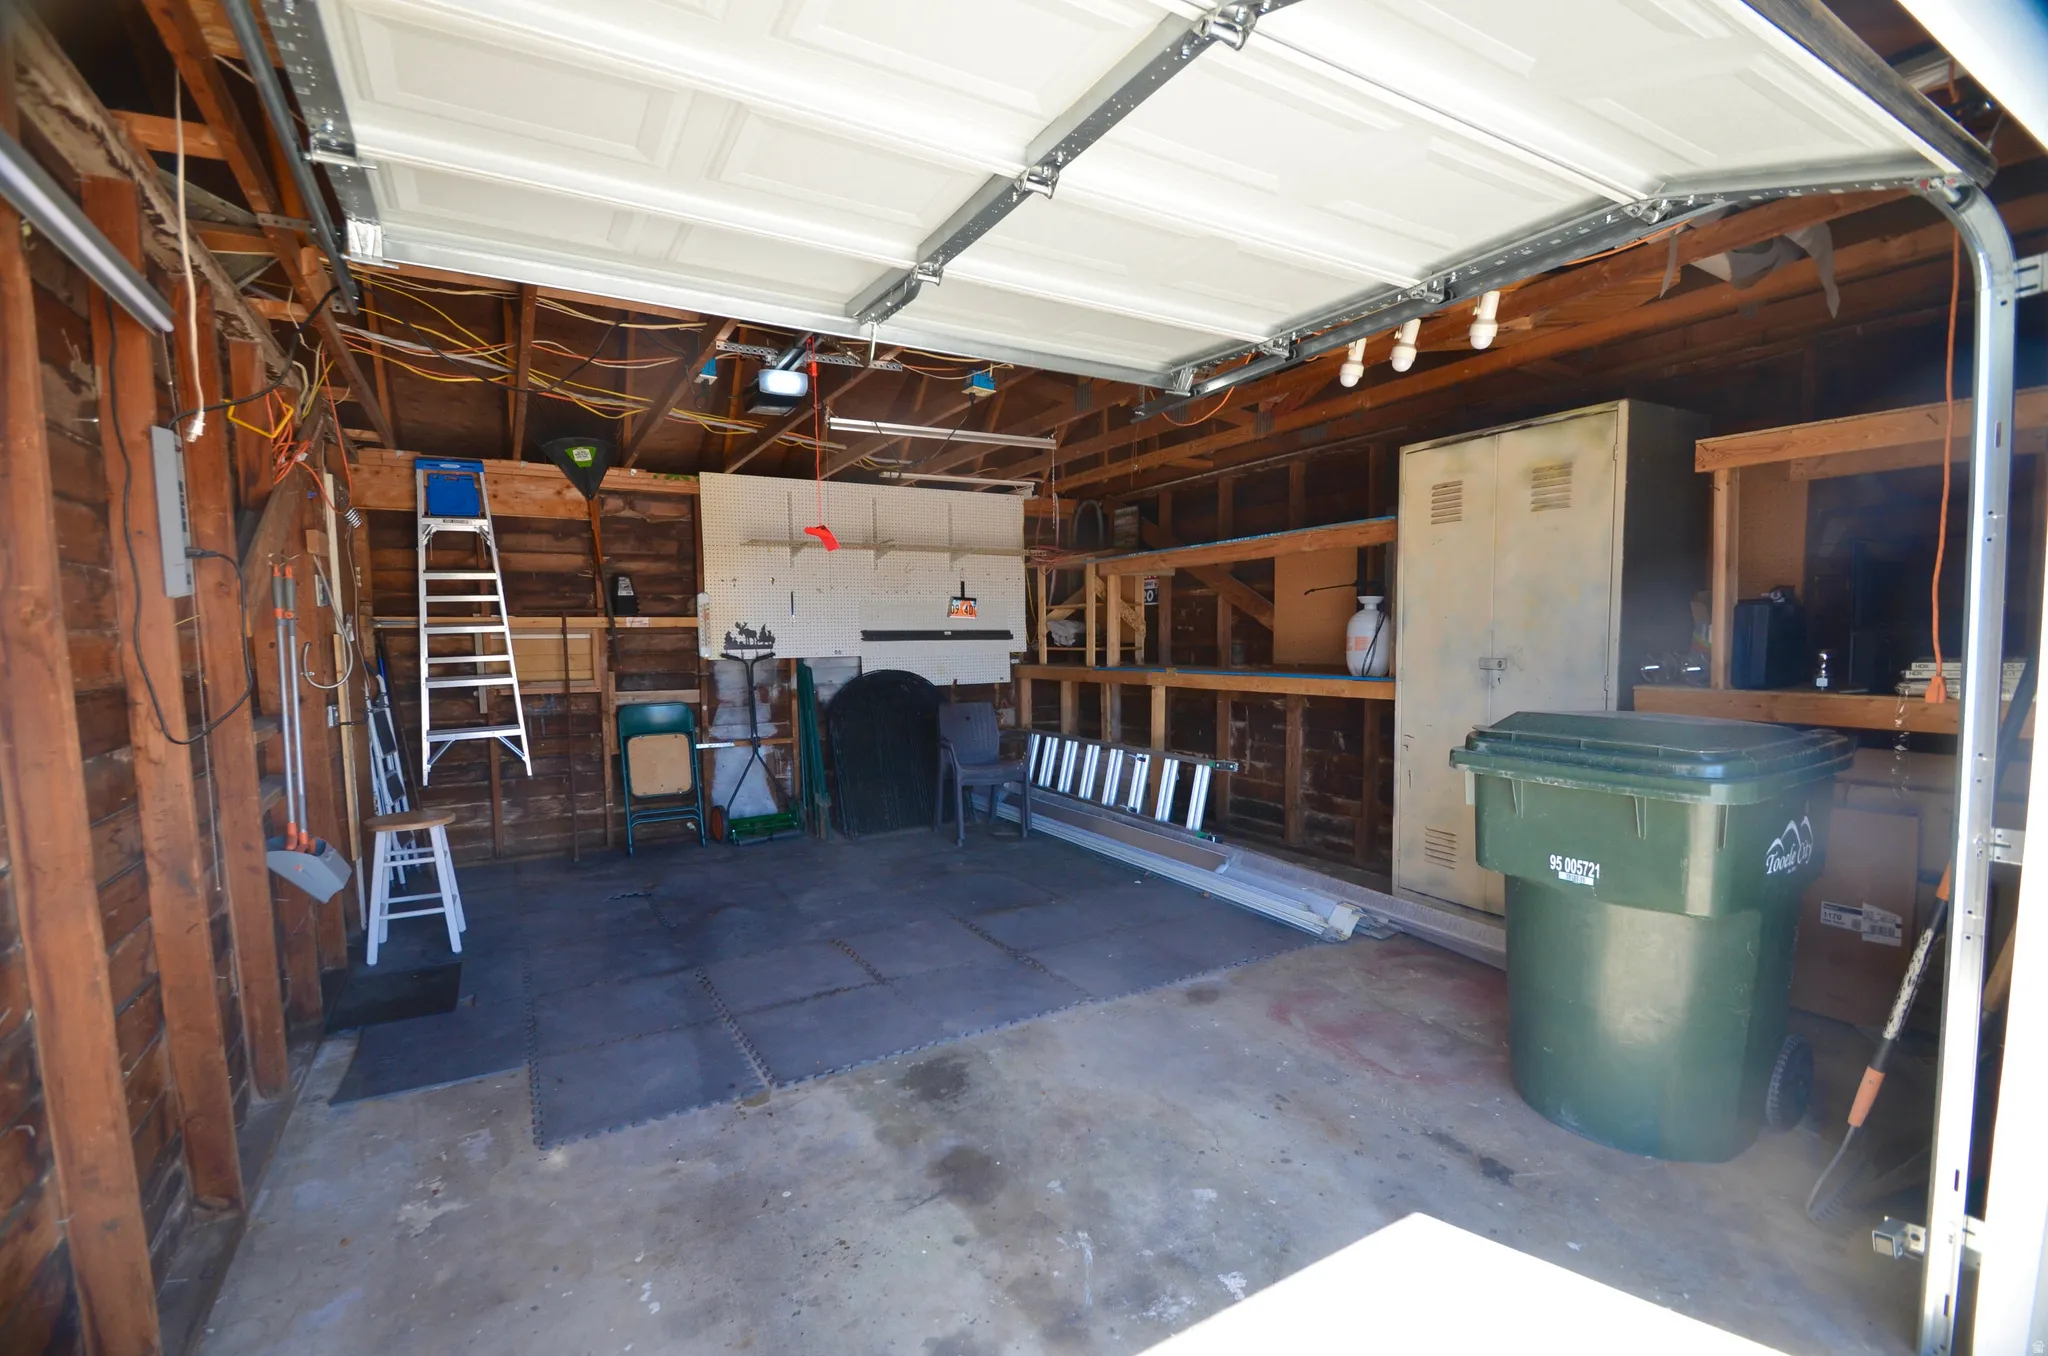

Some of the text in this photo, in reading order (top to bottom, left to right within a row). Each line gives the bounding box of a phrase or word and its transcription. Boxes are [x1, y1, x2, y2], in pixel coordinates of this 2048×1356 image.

[1550, 854, 1562, 871] 95
[1564, 857, 1600, 879] 005721
[1766, 844, 1797, 875] Tooele
